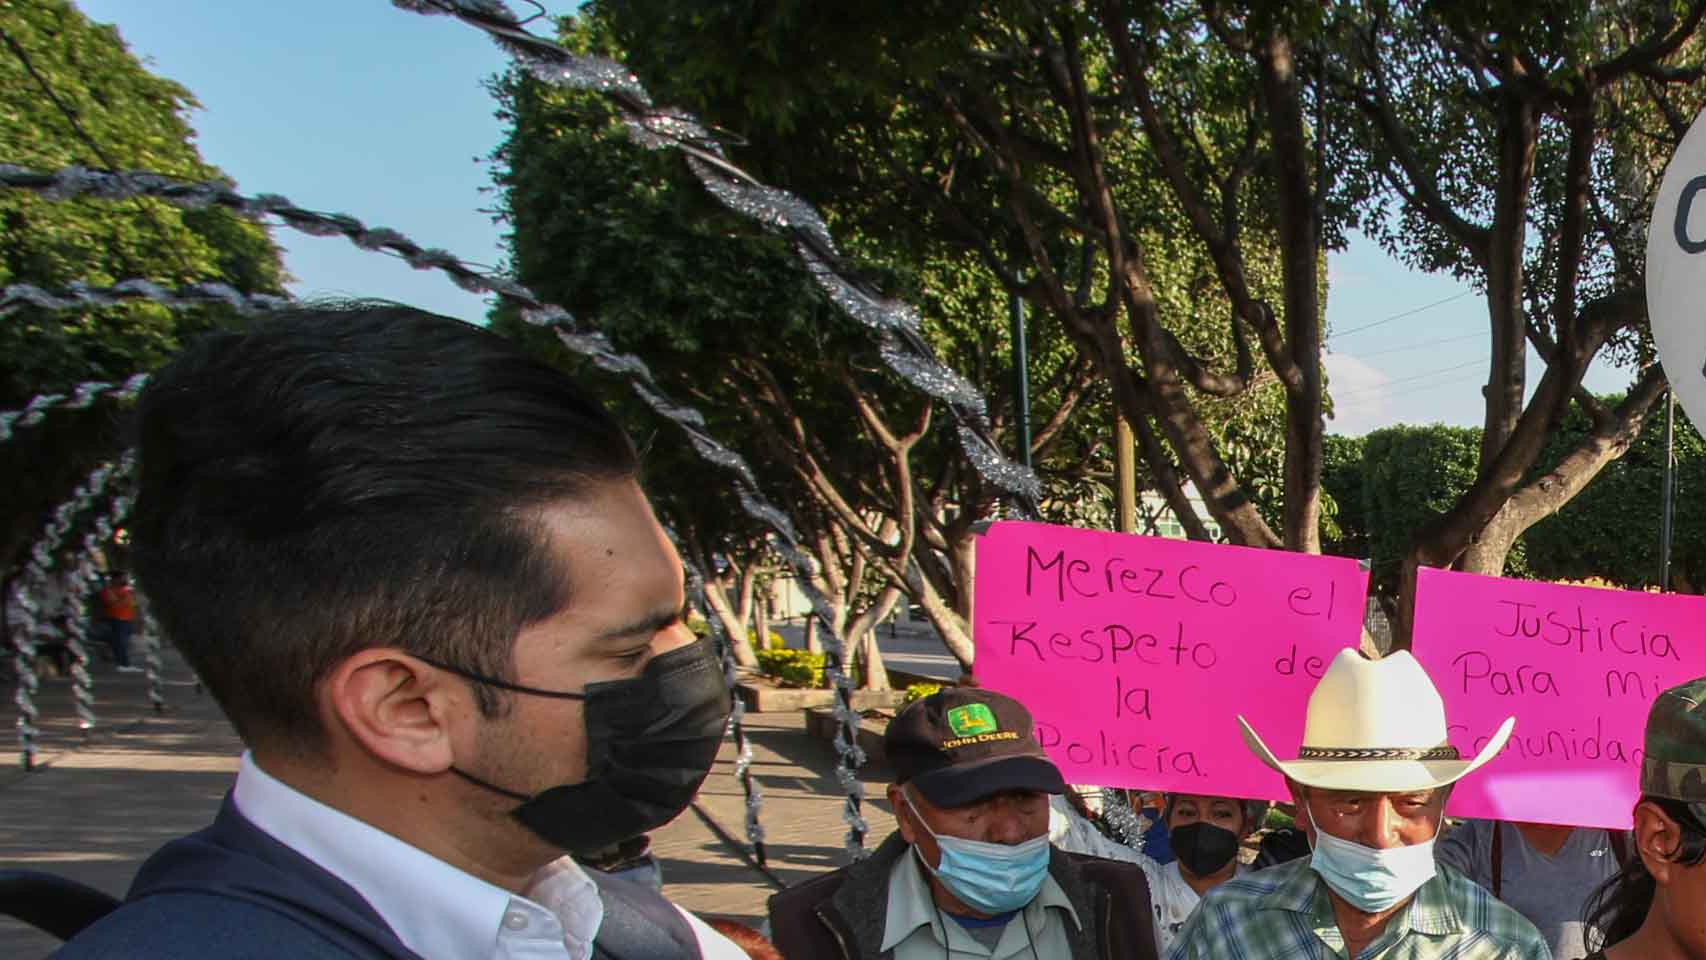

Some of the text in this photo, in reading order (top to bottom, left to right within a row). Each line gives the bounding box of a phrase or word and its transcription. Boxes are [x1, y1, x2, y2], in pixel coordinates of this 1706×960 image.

[1288, 581, 1336, 620] el
[1275, 645, 1324, 679] de
[1452, 651, 1560, 697] Para
[1116, 676, 1152, 721] la
